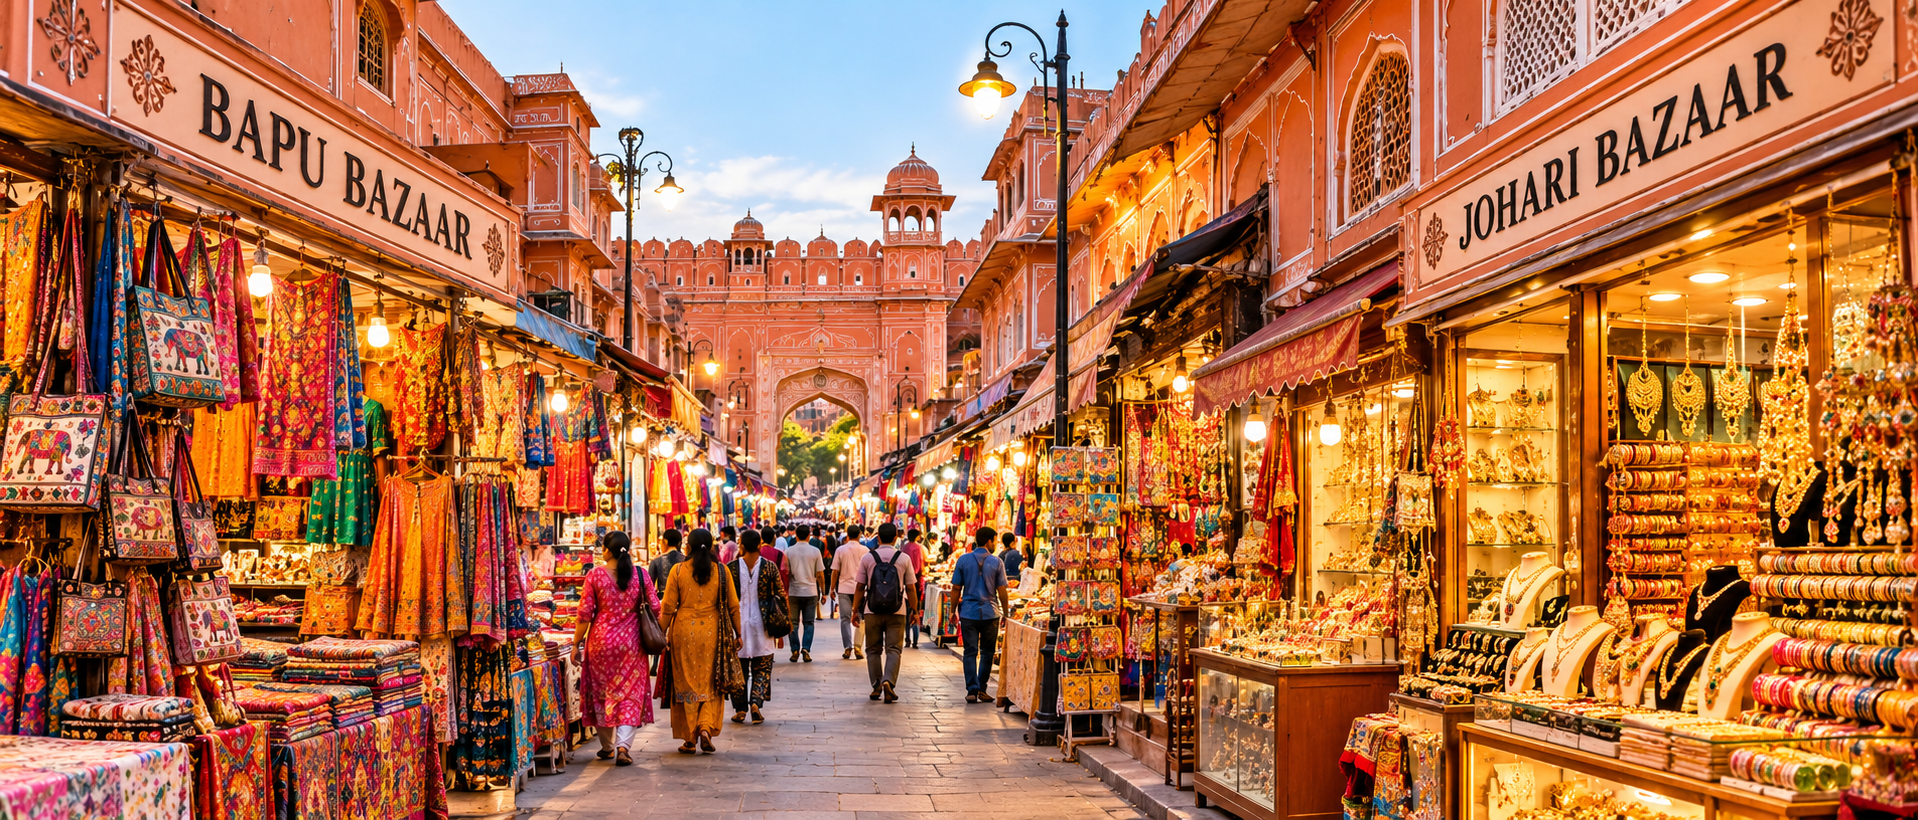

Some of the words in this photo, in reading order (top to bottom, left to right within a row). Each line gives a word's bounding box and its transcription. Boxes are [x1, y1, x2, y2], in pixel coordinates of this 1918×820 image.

[198, 72, 328, 189] BAPU
[342, 151, 473, 260] BAZAAR
[1459, 146, 1580, 250] JOHARI
[1594, 42, 1794, 188] BAZAAR
